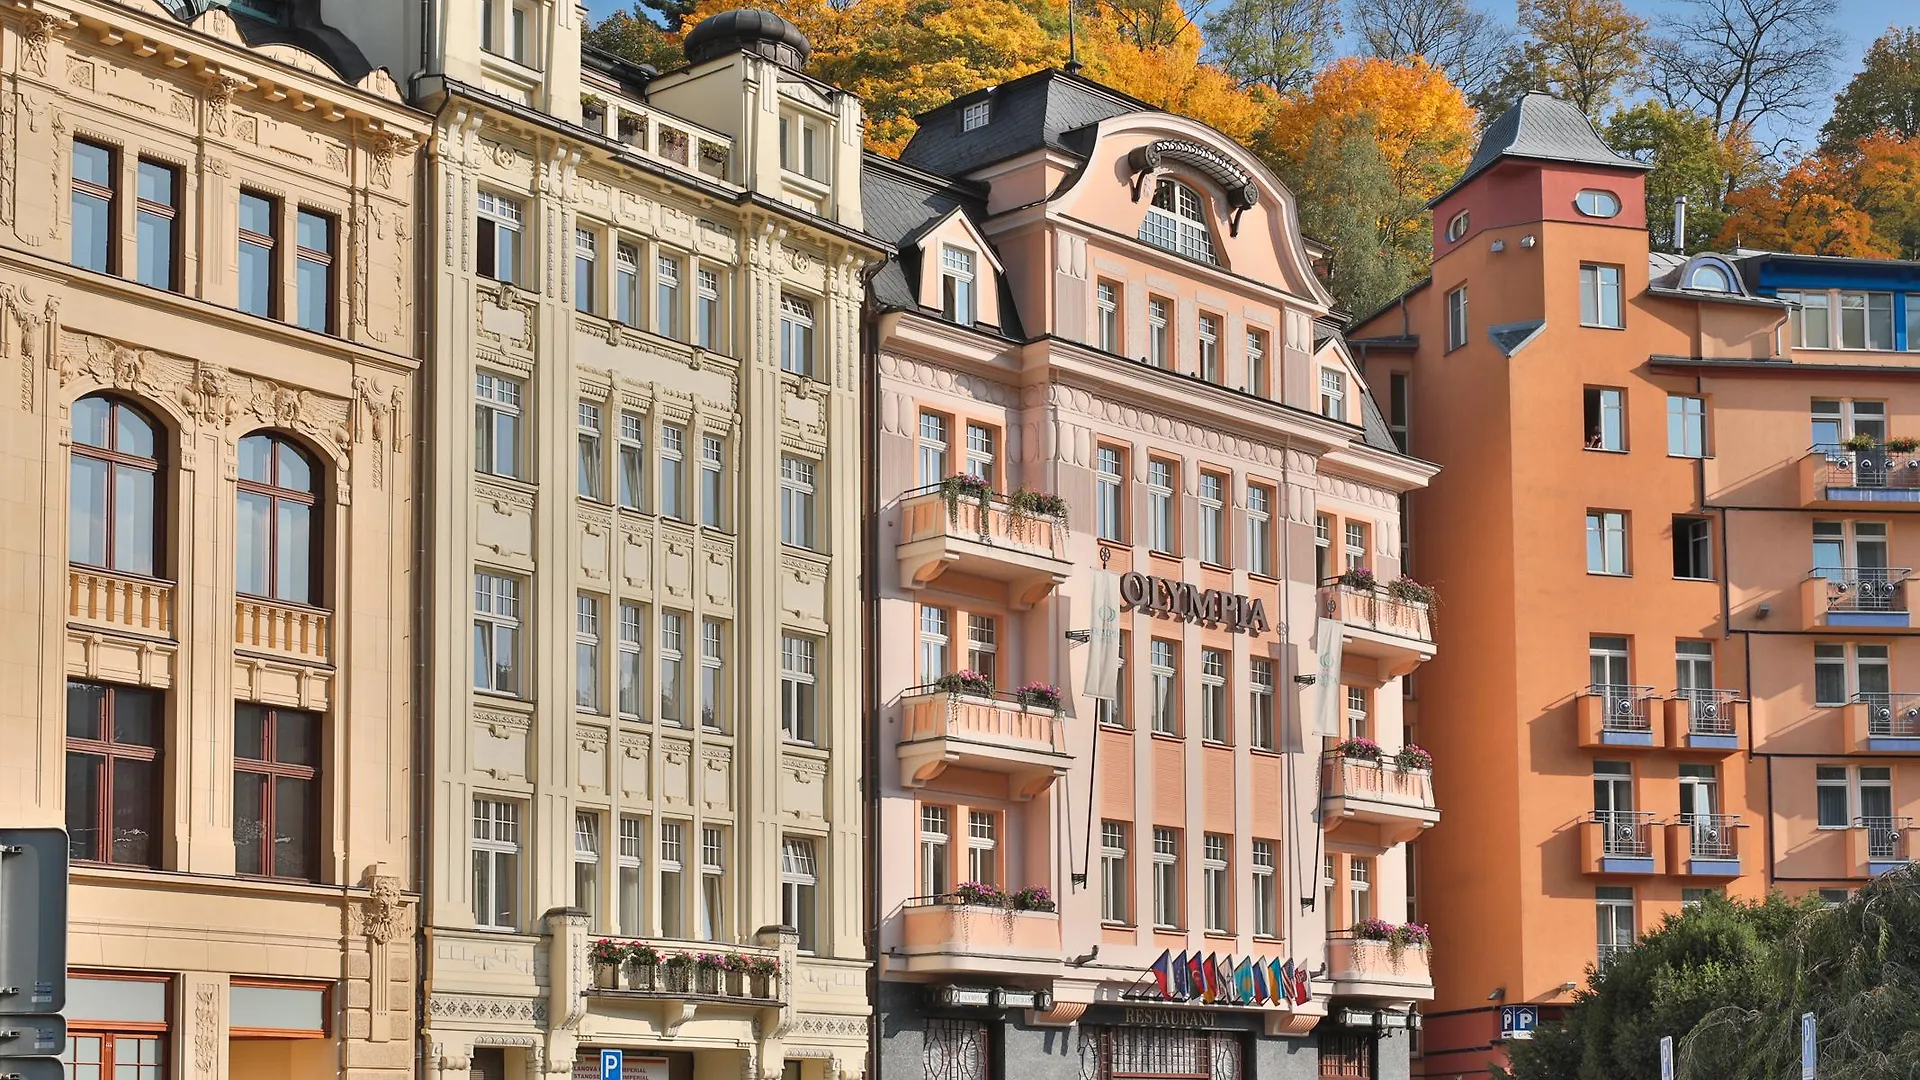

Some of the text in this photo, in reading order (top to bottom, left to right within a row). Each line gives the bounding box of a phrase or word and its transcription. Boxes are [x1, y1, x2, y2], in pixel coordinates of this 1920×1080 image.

[1120, 571, 1271, 633] OLYMPIA
[1125, 1007, 1217, 1027] RESTAURANT
[1504, 1014, 1512, 1029] P
[1519, 1013, 1532, 1029] P
[605, 1054, 618, 1078] P
